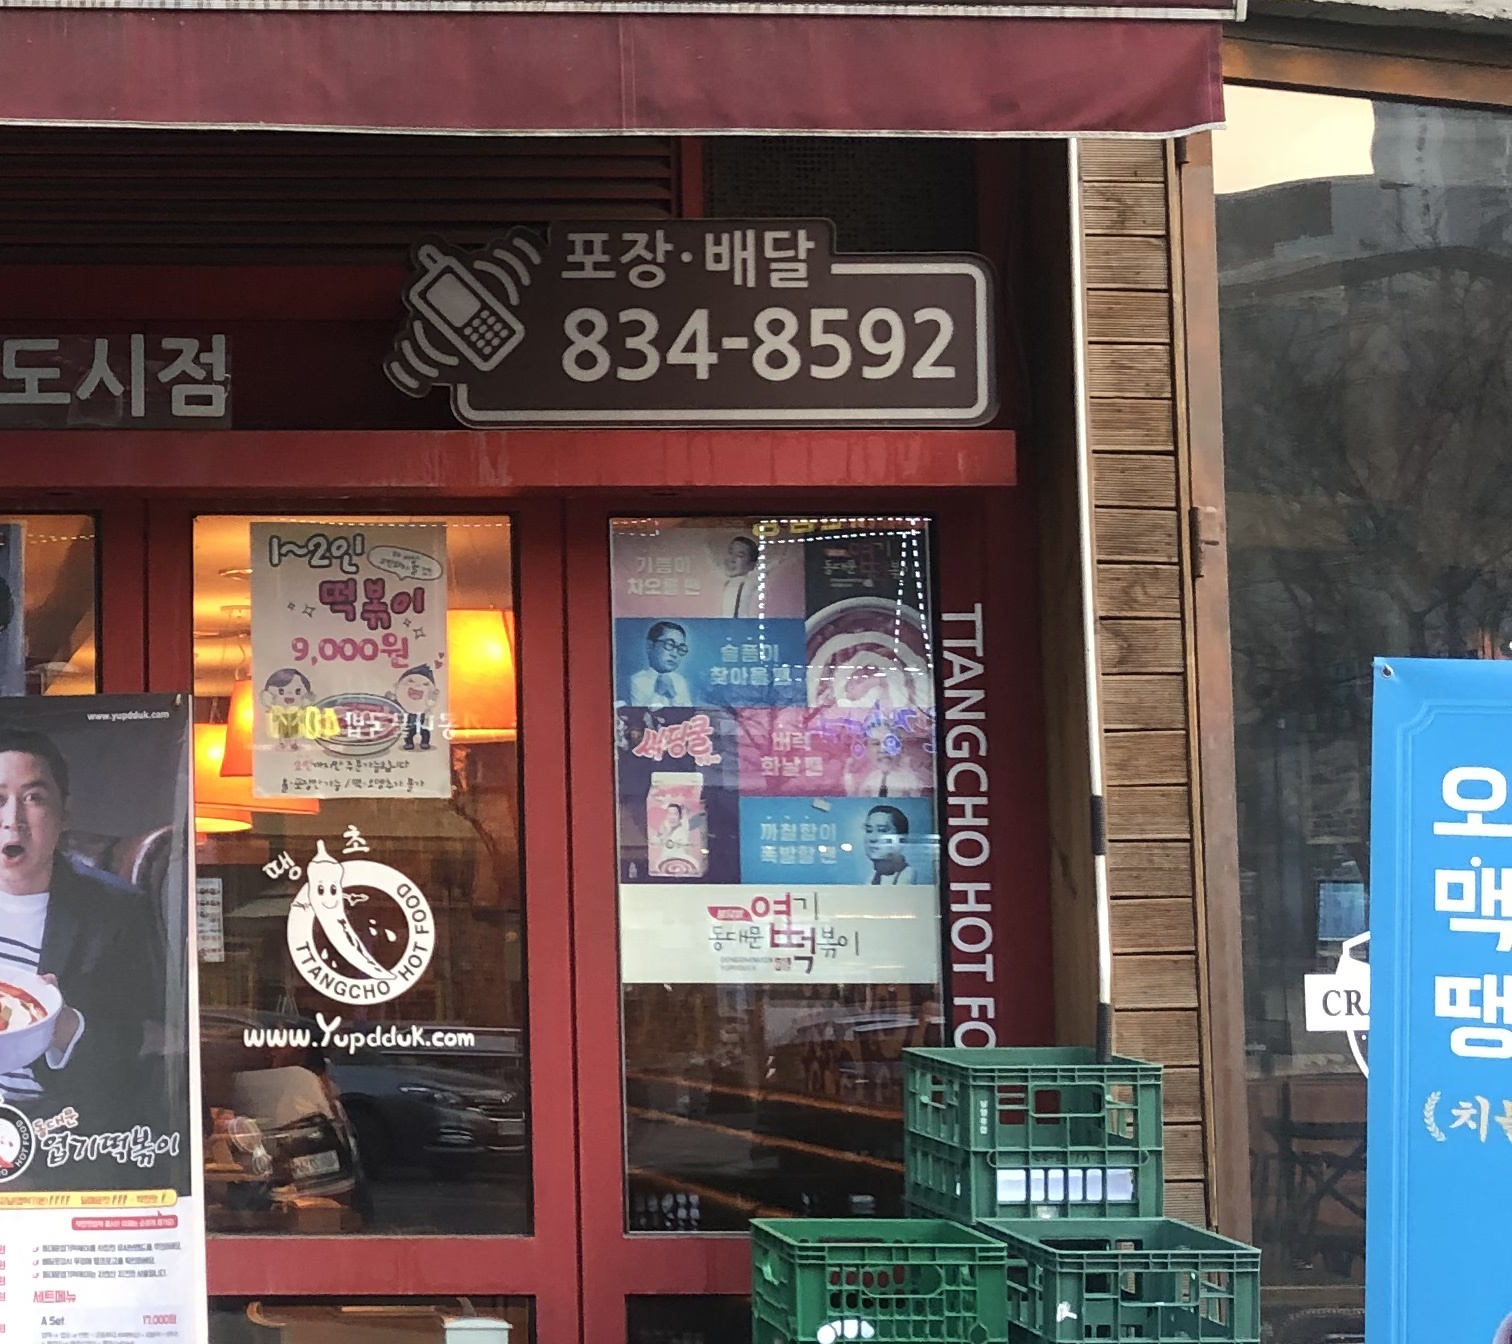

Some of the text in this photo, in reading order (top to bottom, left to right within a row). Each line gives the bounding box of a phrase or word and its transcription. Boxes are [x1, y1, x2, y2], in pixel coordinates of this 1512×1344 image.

[560, 306, 959, 382] 834-8592
[318, 577, 426, 631] 떡볶이
[291, 632, 410, 669] 9,000원
[940, 602, 997, 1049] TTANGCHO HOT FO
[397, 883, 429, 935] FOOD
[295, 941, 429, 1000] TTANGCHO HOT
[242, 1012, 476, 1054] www.Yupdduk.com
[41, 1126, 180, 1167] 엽기떡볶이
